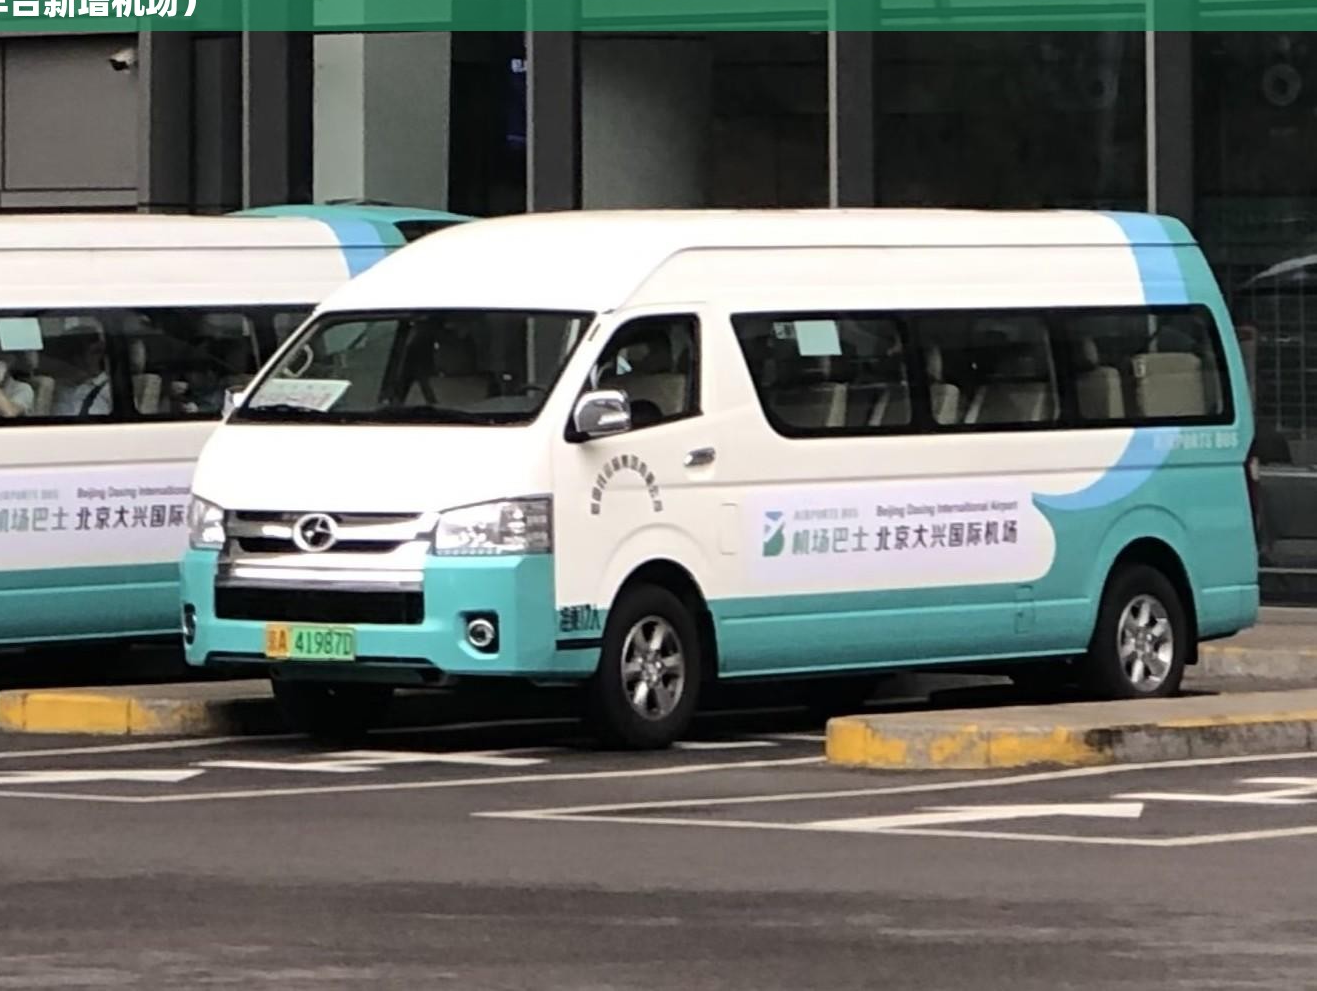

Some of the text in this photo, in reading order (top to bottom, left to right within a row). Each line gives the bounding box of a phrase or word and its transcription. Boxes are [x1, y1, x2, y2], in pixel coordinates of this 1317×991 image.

[792, 525, 870, 556] 机场巴士
[874, 520, 1018, 552] 北京大兴国际机场
